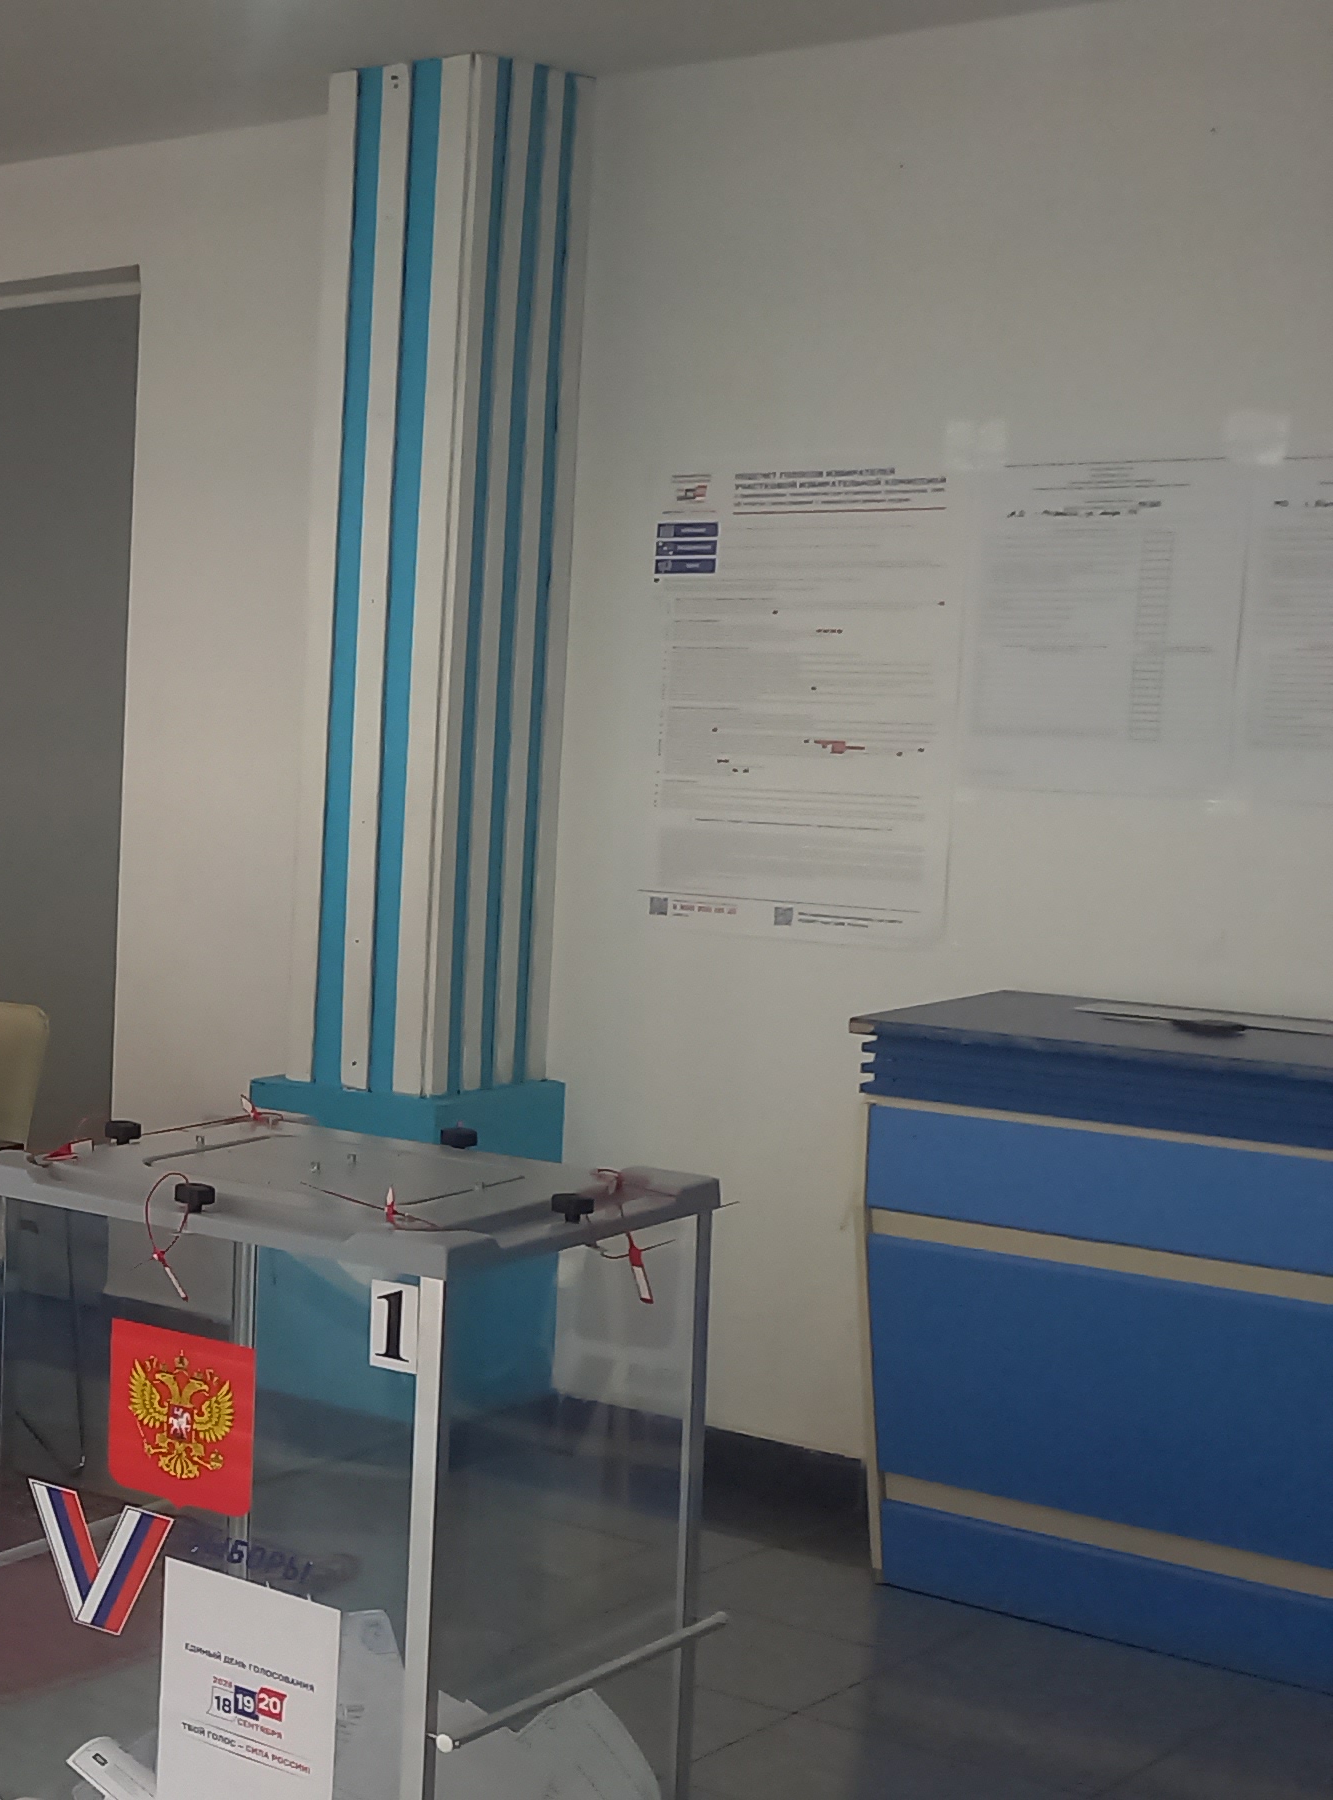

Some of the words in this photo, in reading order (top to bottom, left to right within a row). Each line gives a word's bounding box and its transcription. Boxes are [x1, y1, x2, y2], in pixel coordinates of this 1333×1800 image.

[374, 1289, 411, 1362] 1
[184, 1643, 222, 1661] ЕДИНЫЙ
[223, 1656, 247, 1669] ДЕНЬ
[248, 1664, 315, 1693] ГОЛОСОВАНИЯ
[214, 1695, 232, 1714] 18
[235, 1693, 254, 1713] 19
[258, 1693, 281, 1714] 20
[182, 1722, 205, 1739] ТВОЙ
[207, 1730, 236, 1748] ГОЛОС
[245, 1745, 270, 1760] СИЛА
[237, 1719, 283, 1739] СЕНТЯБРЯ
